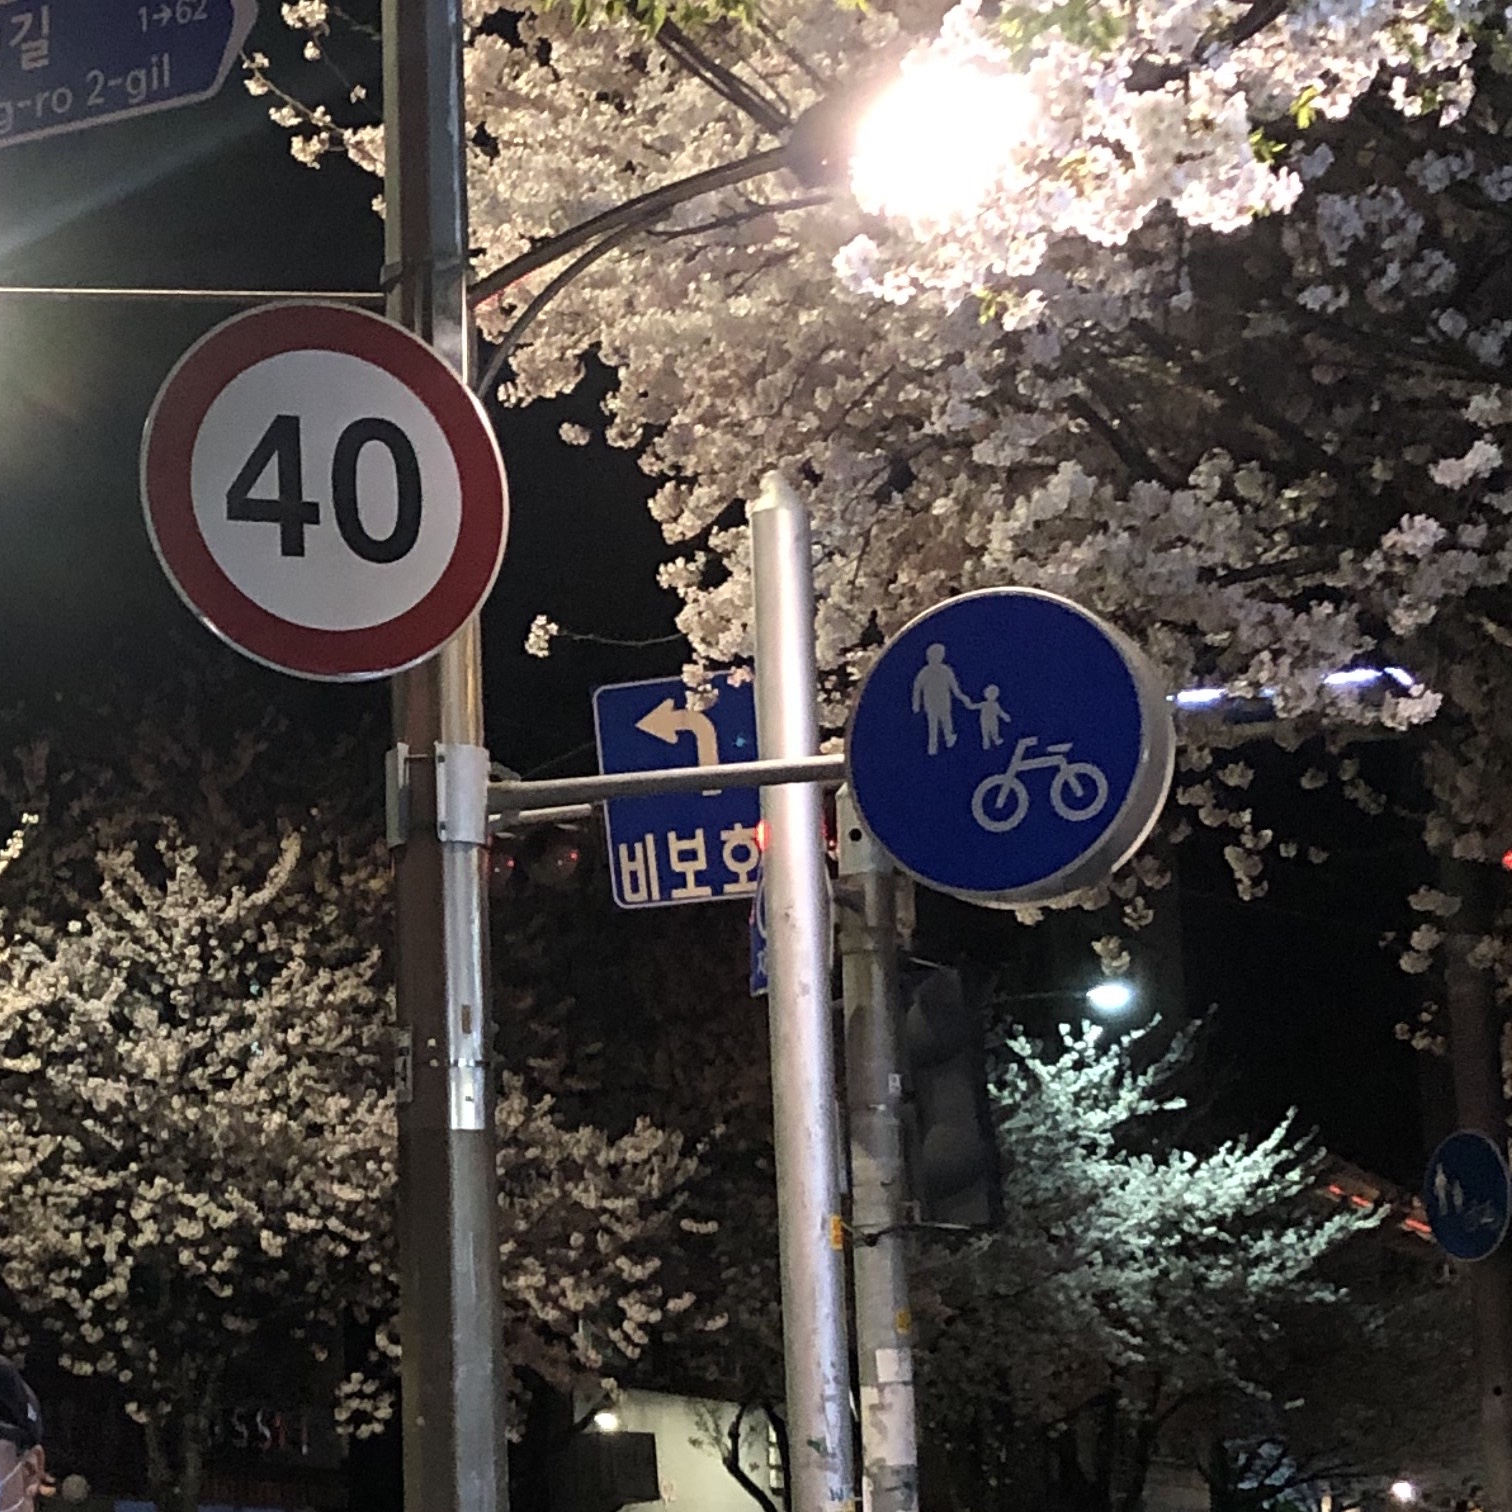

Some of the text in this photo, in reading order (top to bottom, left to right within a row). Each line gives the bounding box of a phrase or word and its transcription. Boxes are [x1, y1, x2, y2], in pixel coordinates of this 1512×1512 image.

[85, 52, 173, 107] 2-gil
[225, 413, 423, 565] 40
[618, 822, 763, 903] 비보호
